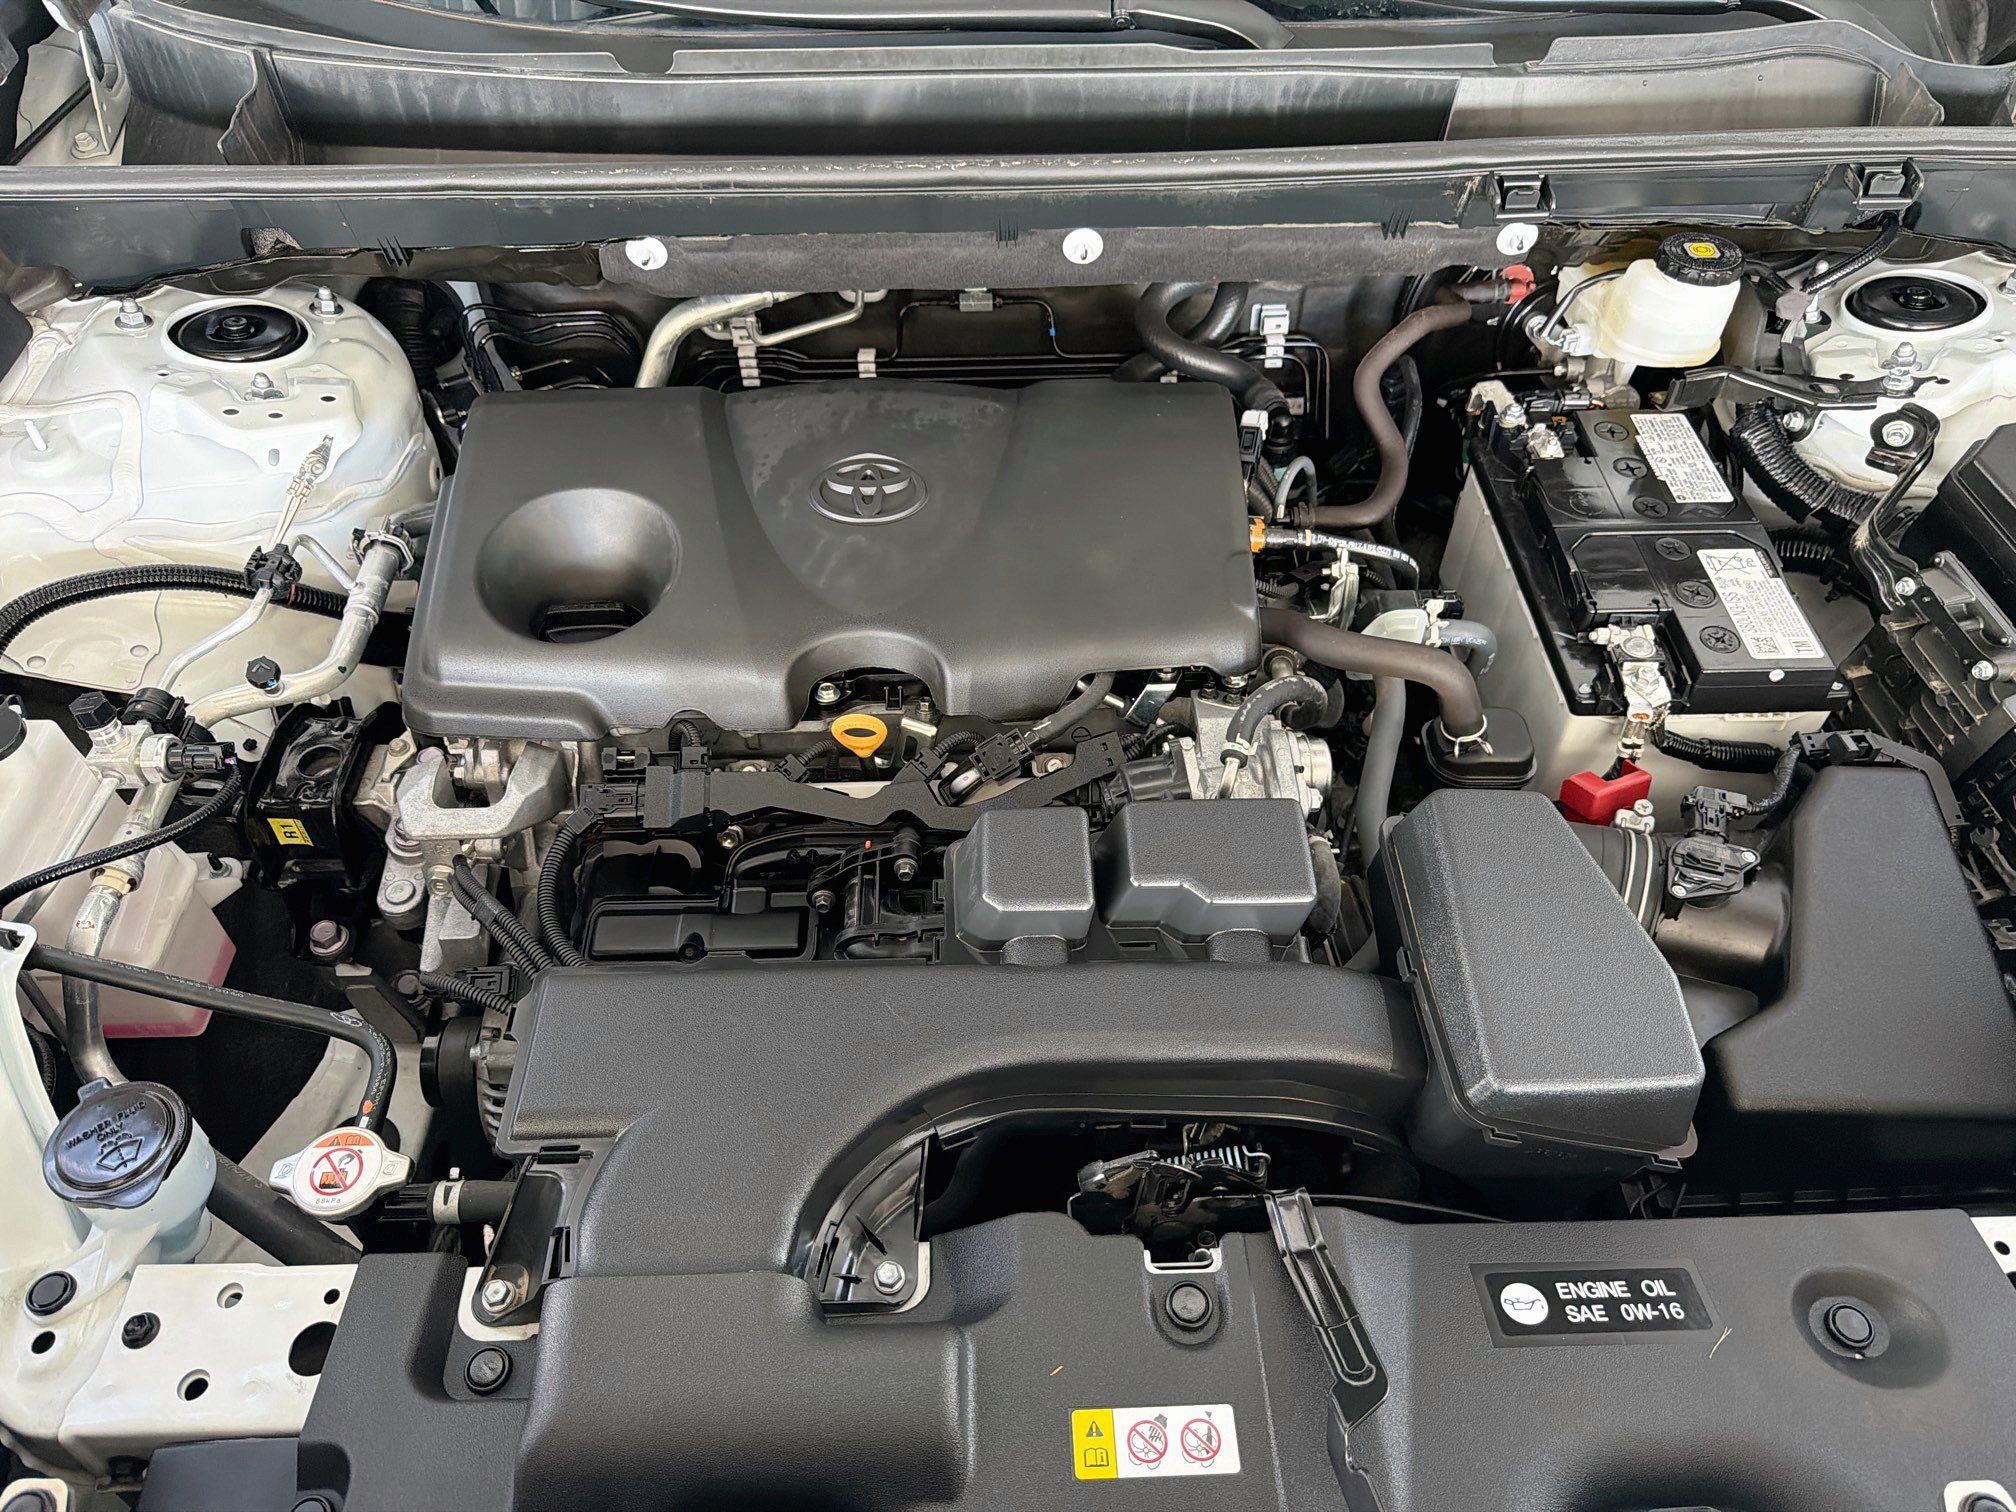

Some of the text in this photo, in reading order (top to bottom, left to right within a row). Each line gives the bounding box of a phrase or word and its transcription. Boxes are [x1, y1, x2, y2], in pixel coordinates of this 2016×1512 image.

[280, 824, 299, 839] R1
[65, 1119, 111, 1149] WASHER
[97, 1121, 124, 1141] ONLY
[1555, 1279, 1677, 1299] ENGINE OIL
[1564, 1302, 1685, 1322] SAE 0W-16
